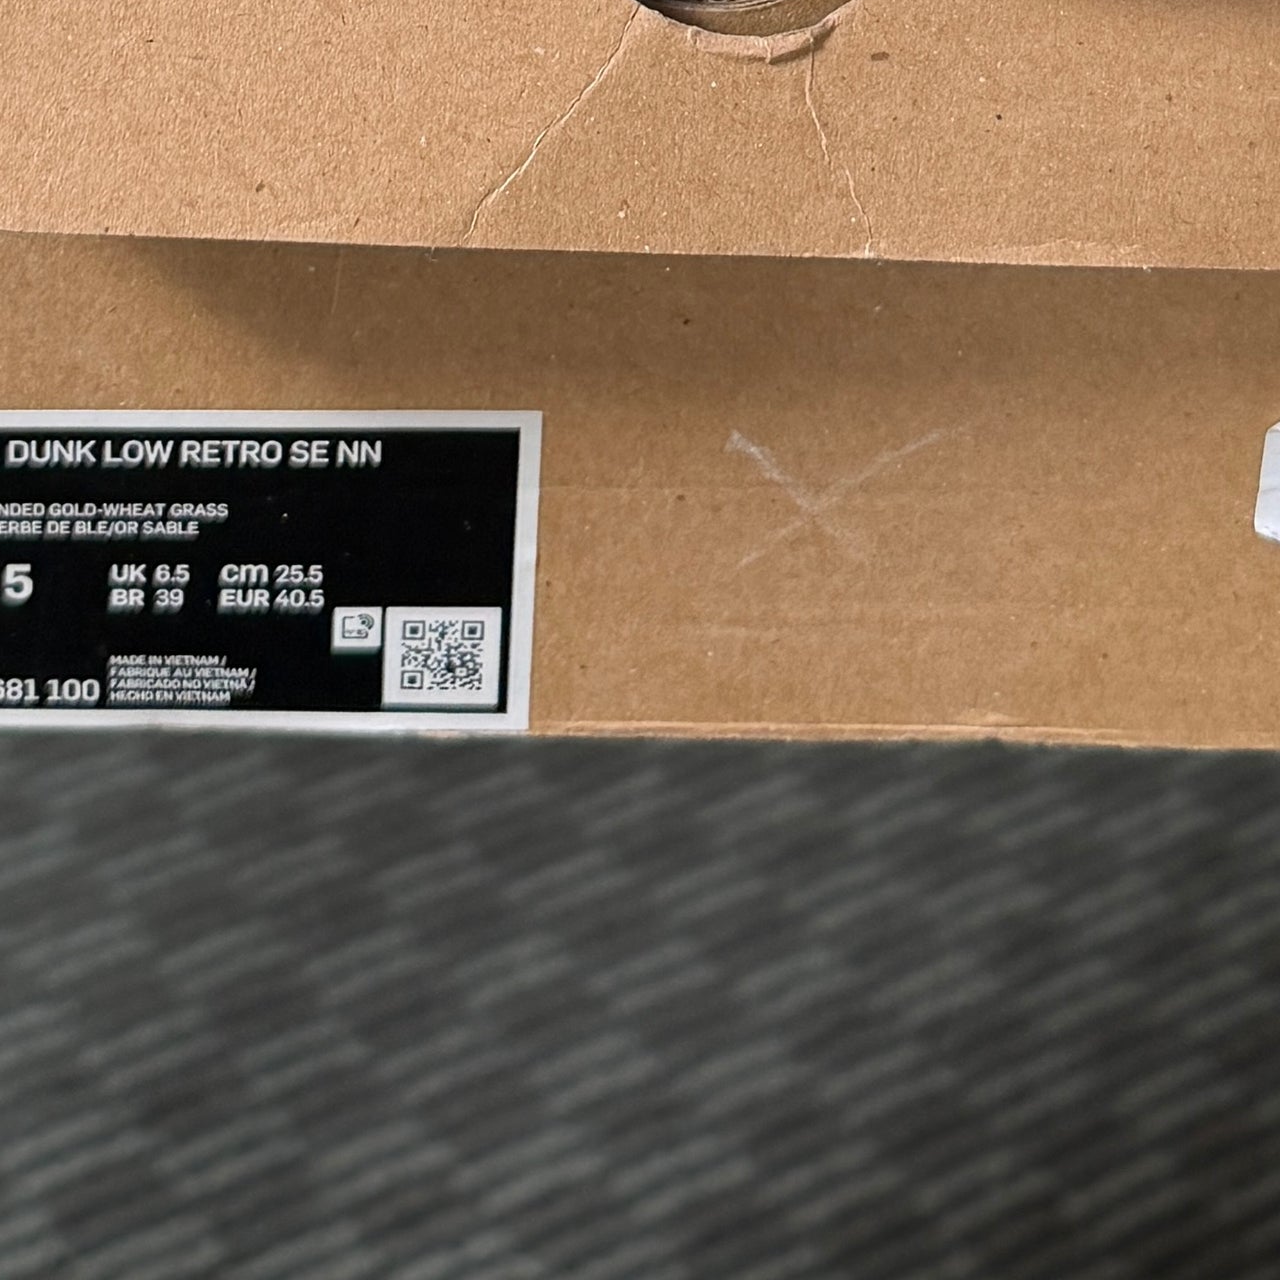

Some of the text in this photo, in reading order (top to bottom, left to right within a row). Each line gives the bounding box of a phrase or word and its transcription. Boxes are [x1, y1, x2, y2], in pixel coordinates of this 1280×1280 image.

[6, 439, 97, 466] DUNK
[102, 439, 175, 466] LOW
[180, 439, 283, 466] RETRO
[288, 439, 330, 466] SE
[336, 439, 383, 466] NN
[48, 502, 167, 519] GOLD-WHEAT
[168, 502, 229, 520] GRASS
[46, 520, 71, 536] DE
[74, 520, 139, 537] BLE/OR
[142, 520, 200, 536] SABLE
[109, 563, 191, 584] UK 6.5
[274, 564, 324, 585] 25.5
[109, 588, 185, 608] BR 39
[219, 588, 326, 608] EUR 40.5
[109, 654, 146, 666] MADE
[46, 677, 101, 702] 100
